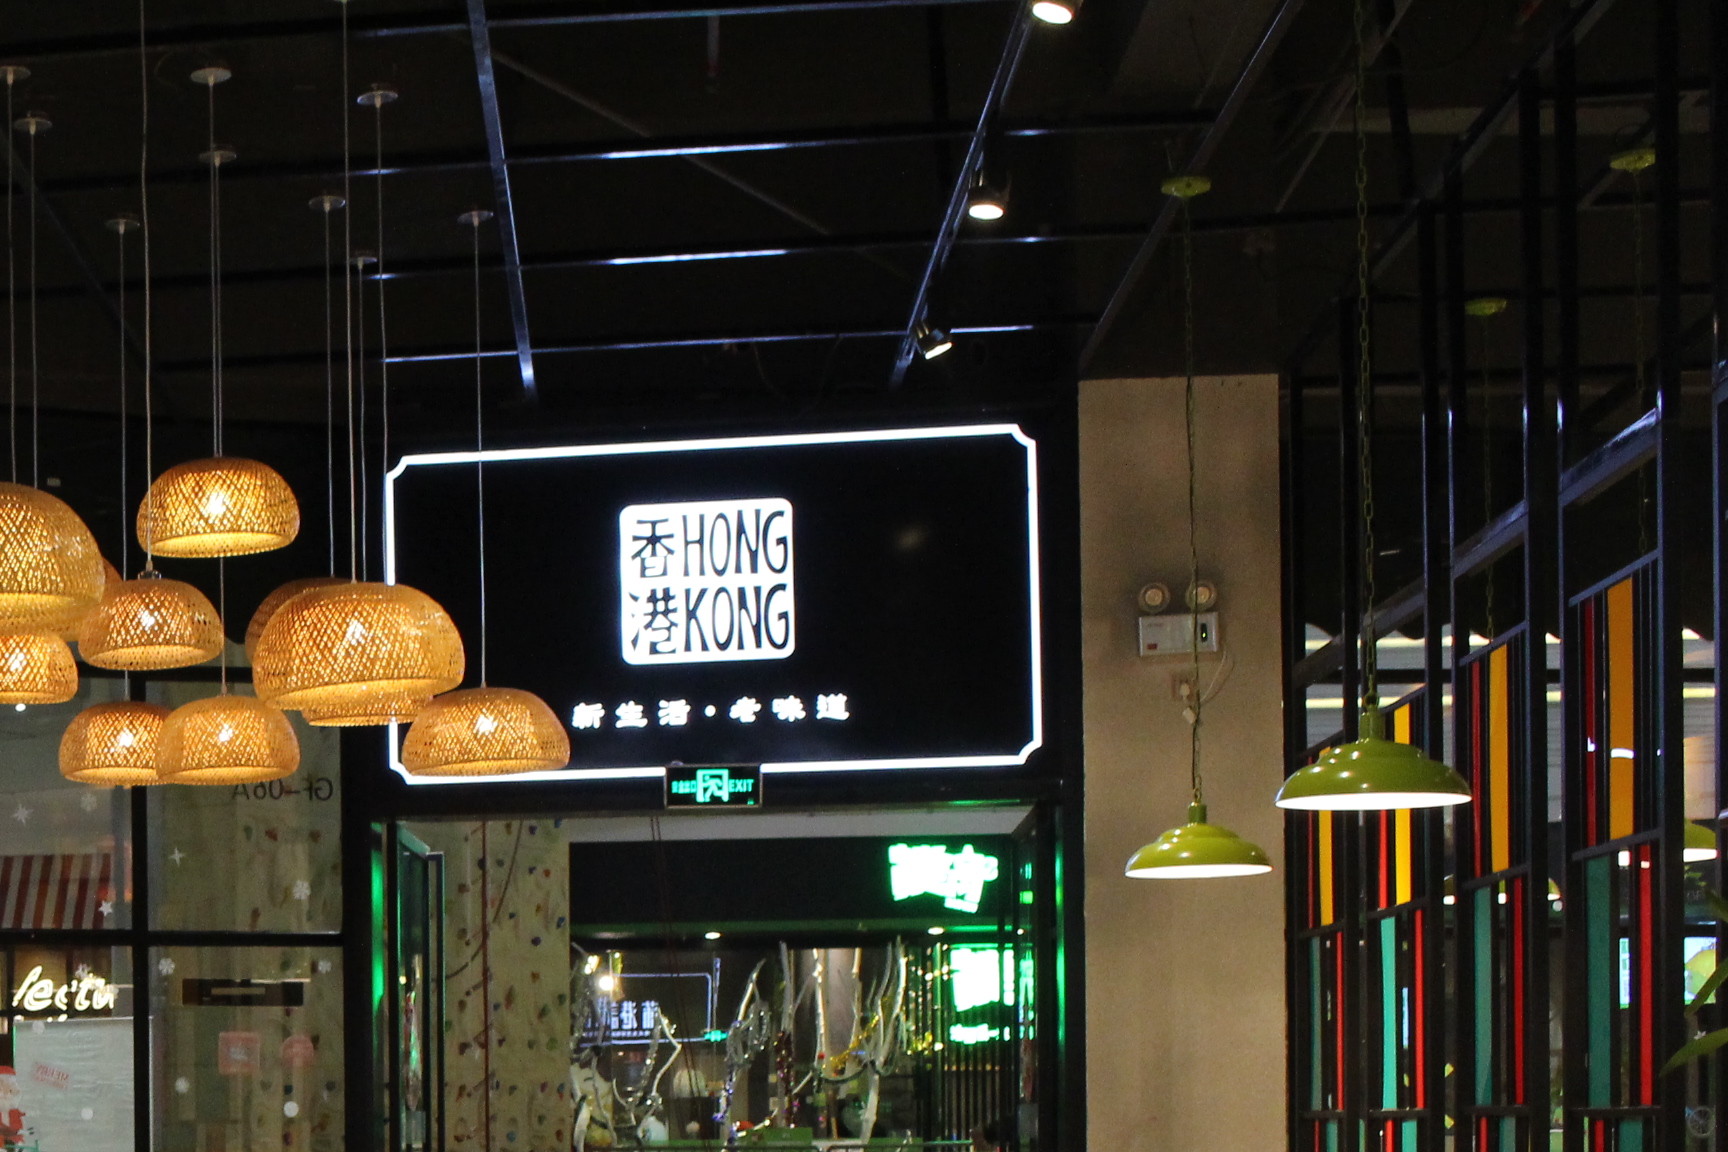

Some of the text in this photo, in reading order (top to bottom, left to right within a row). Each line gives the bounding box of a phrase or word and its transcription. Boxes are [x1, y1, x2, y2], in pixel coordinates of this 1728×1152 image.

[682, 508, 789, 577] HONG
[629, 518, 678, 655] 香港
[684, 583, 790, 653] KONG
[572, 693, 850, 730] 新生活·老味道
[728, 779, 754, 793] EXIT
